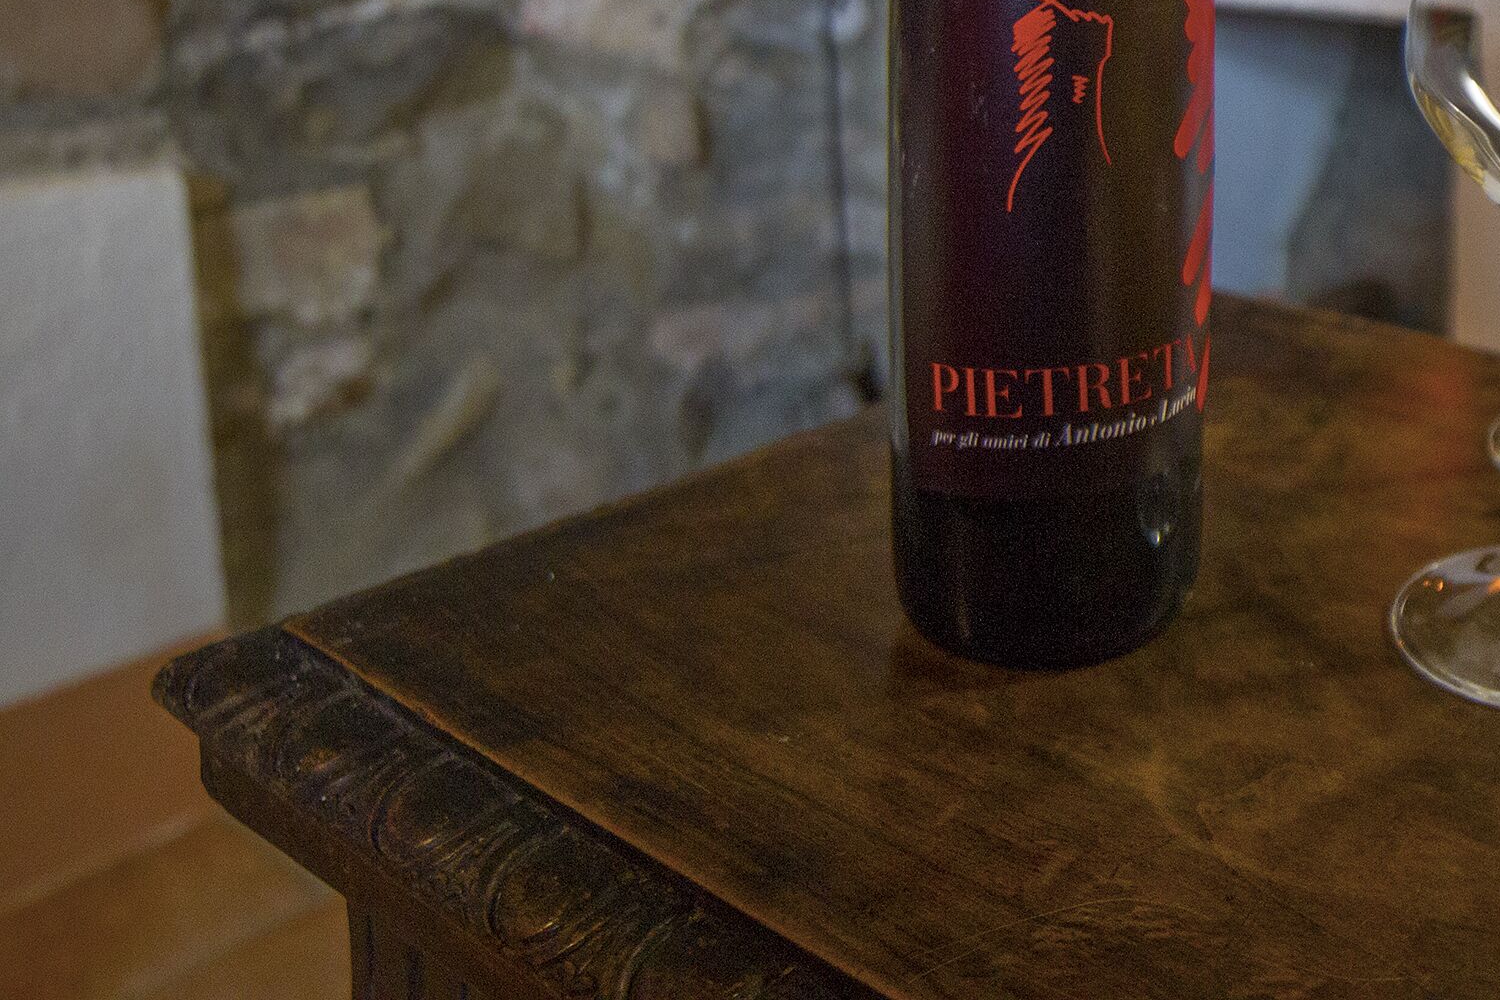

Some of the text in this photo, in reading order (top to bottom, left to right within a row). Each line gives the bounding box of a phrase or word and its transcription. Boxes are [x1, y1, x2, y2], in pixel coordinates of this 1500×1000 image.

[930, 429, 956, 448] per
[957, 430, 980, 450] gli
[983, 433, 1029, 450] amici
[1033, 430, 1052, 449] di
[1055, 411, 1148, 447] Antonio
